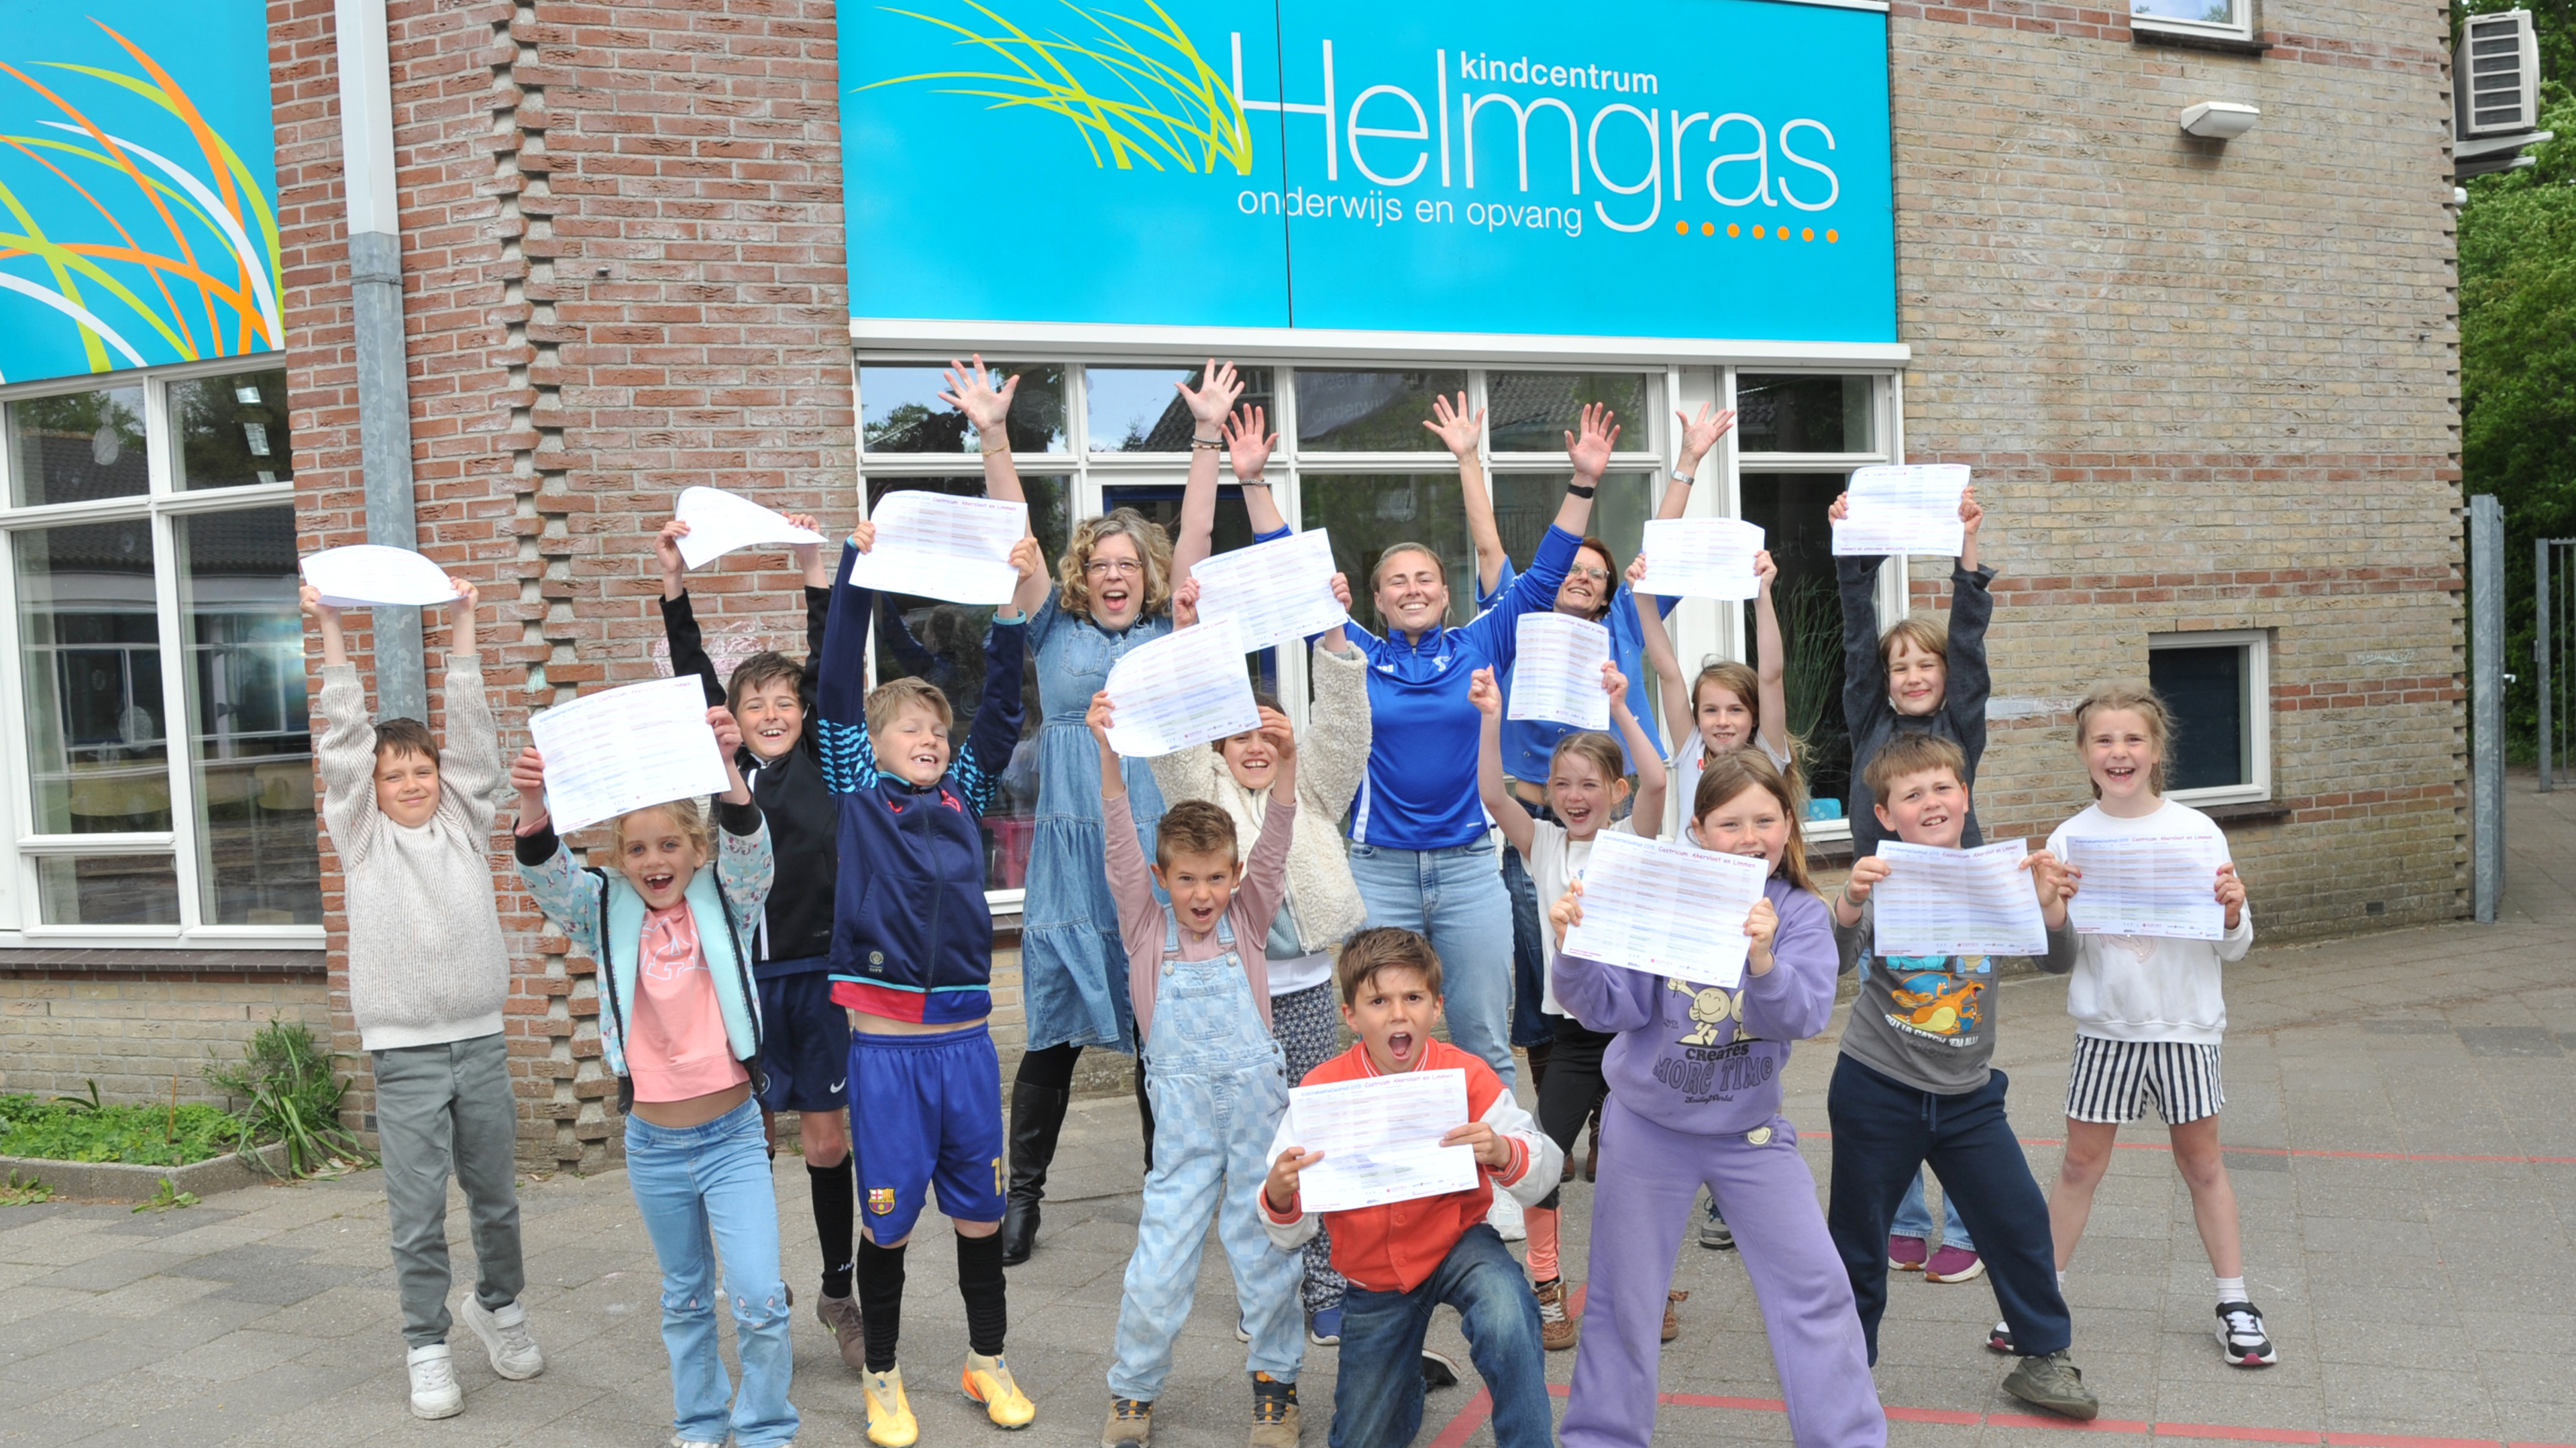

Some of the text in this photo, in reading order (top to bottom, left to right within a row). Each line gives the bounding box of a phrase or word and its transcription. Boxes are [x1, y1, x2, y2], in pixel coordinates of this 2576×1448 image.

[1460, 50, 1658, 95] kindcentrum
[1230, 32, 1839, 233] Helmgras
[1238, 186, 1582, 237] onderwijs en opvang
[1658, 846, 1688, 857] Castricum
[1692, 852, 1721, 862] Akersloot
[1733, 859, 1756, 869] Limmen
